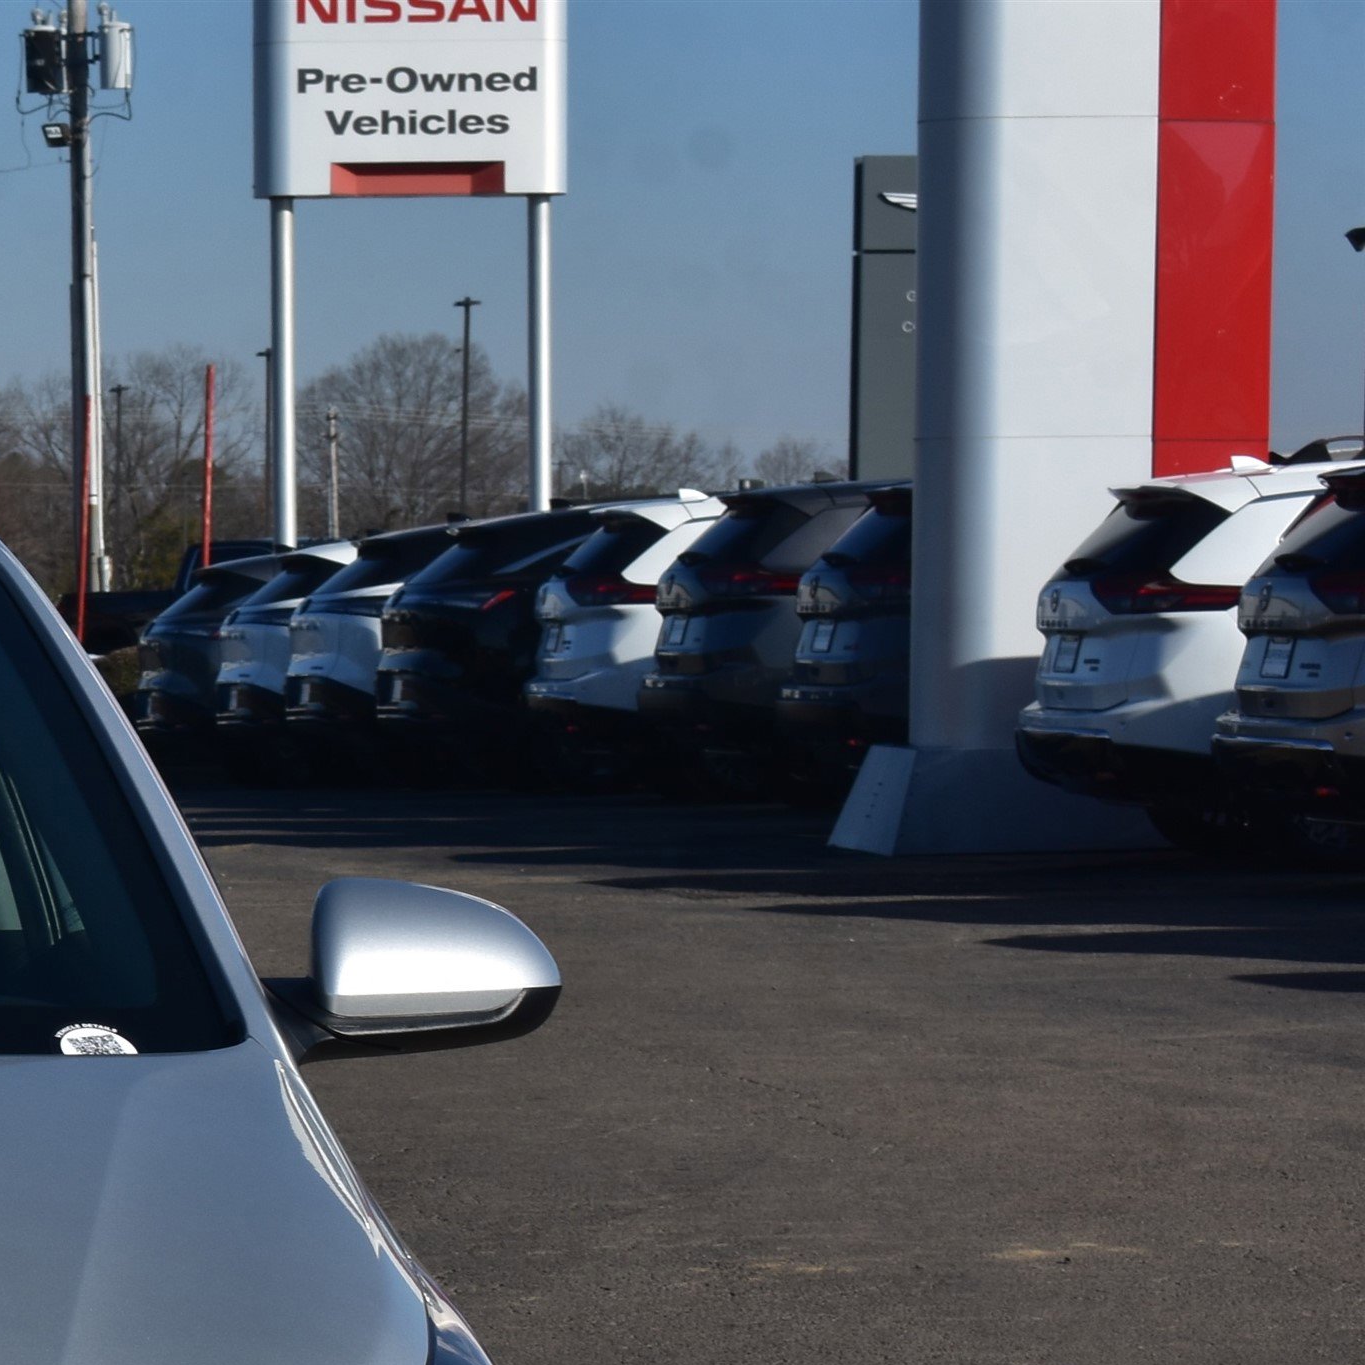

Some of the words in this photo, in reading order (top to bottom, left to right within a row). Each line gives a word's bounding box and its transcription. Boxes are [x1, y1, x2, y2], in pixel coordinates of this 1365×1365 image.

[296, 0, 537, 23] NISSAN
[297, 66, 538, 94] Pre-Owned
[325, 109, 510, 135] Vehicles
